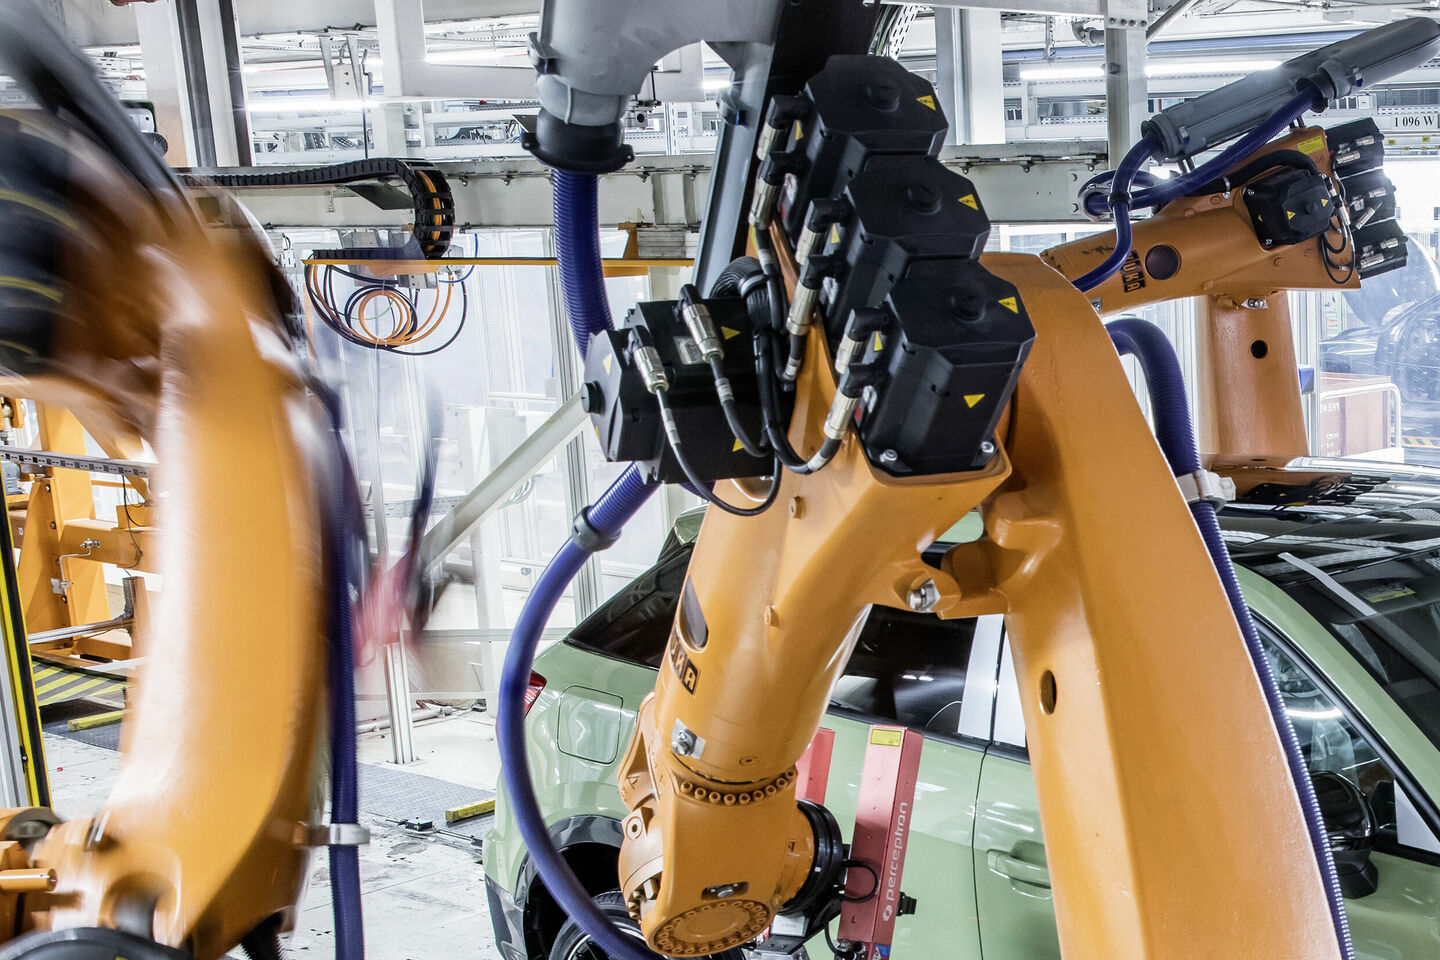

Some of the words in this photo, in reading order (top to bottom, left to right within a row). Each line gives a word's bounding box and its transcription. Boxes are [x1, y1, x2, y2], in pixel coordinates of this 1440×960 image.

[1394, 117, 1399, 128] 1
[1402, 116, 1420, 127] 096
[1423, 115, 1436, 126] W
[886, 801, 908, 901] perceptron
